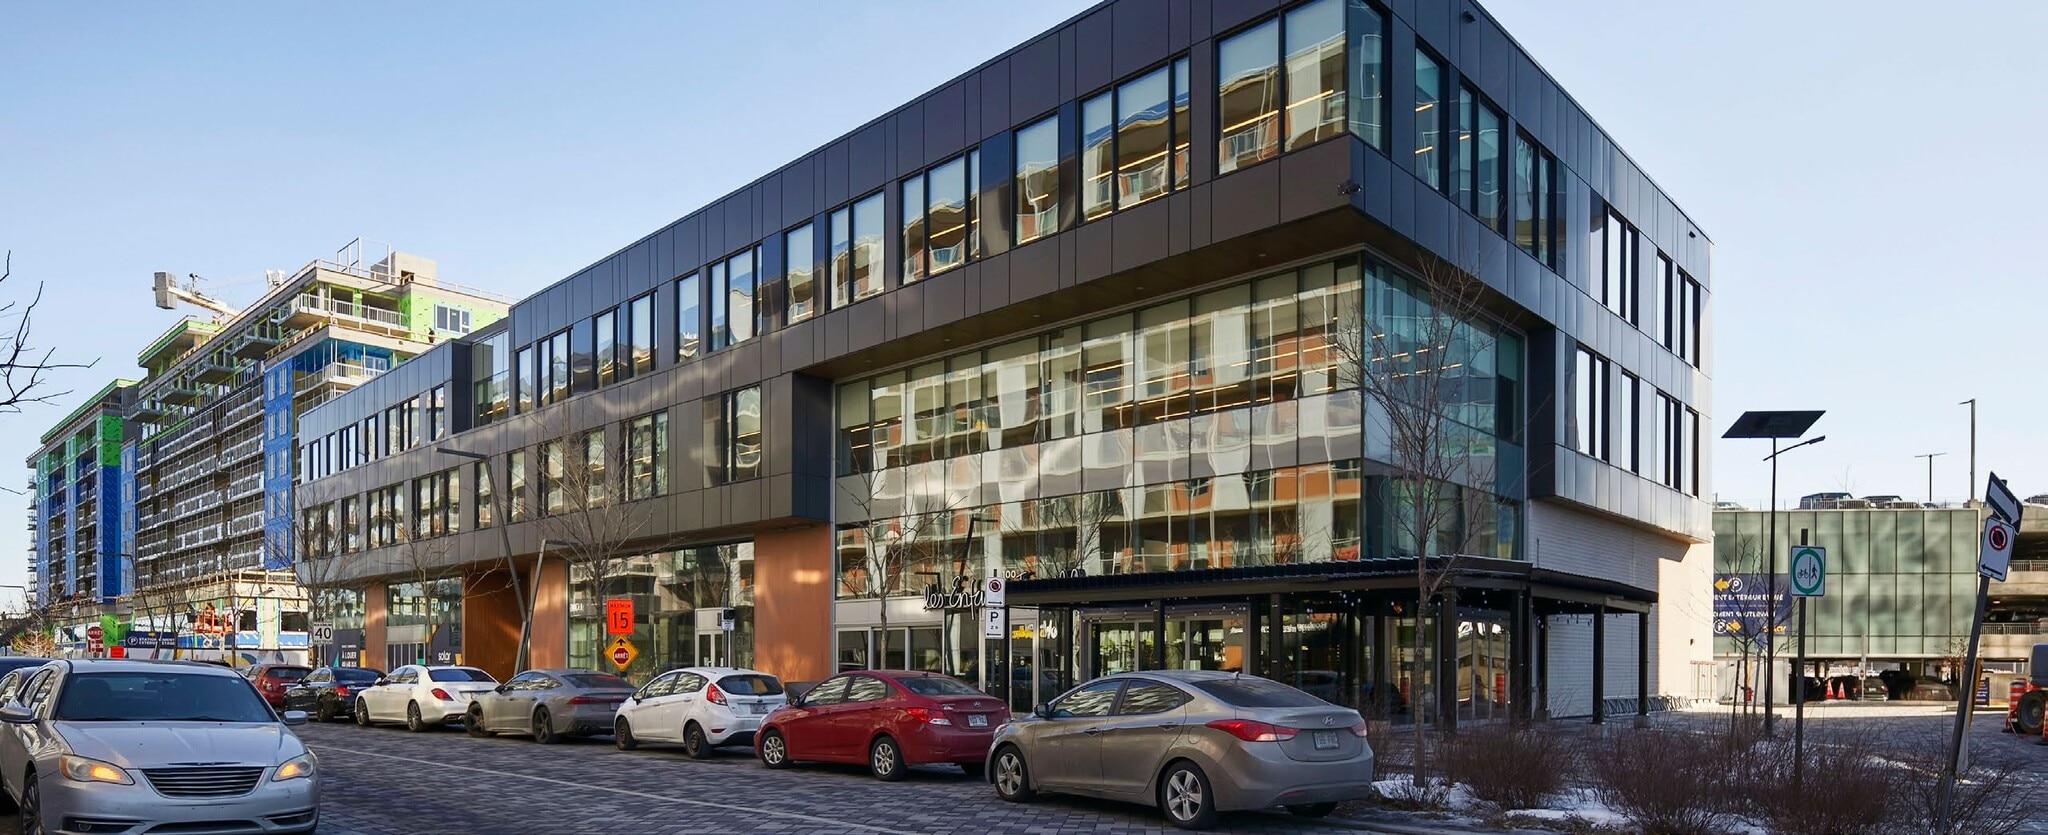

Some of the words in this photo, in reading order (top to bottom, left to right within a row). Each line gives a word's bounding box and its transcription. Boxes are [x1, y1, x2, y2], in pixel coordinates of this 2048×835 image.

[949, 576, 985, 620] Enfa
[613, 611, 629, 629] 15
[990, 611, 999, 622] P
[314, 627, 332, 639] 40
